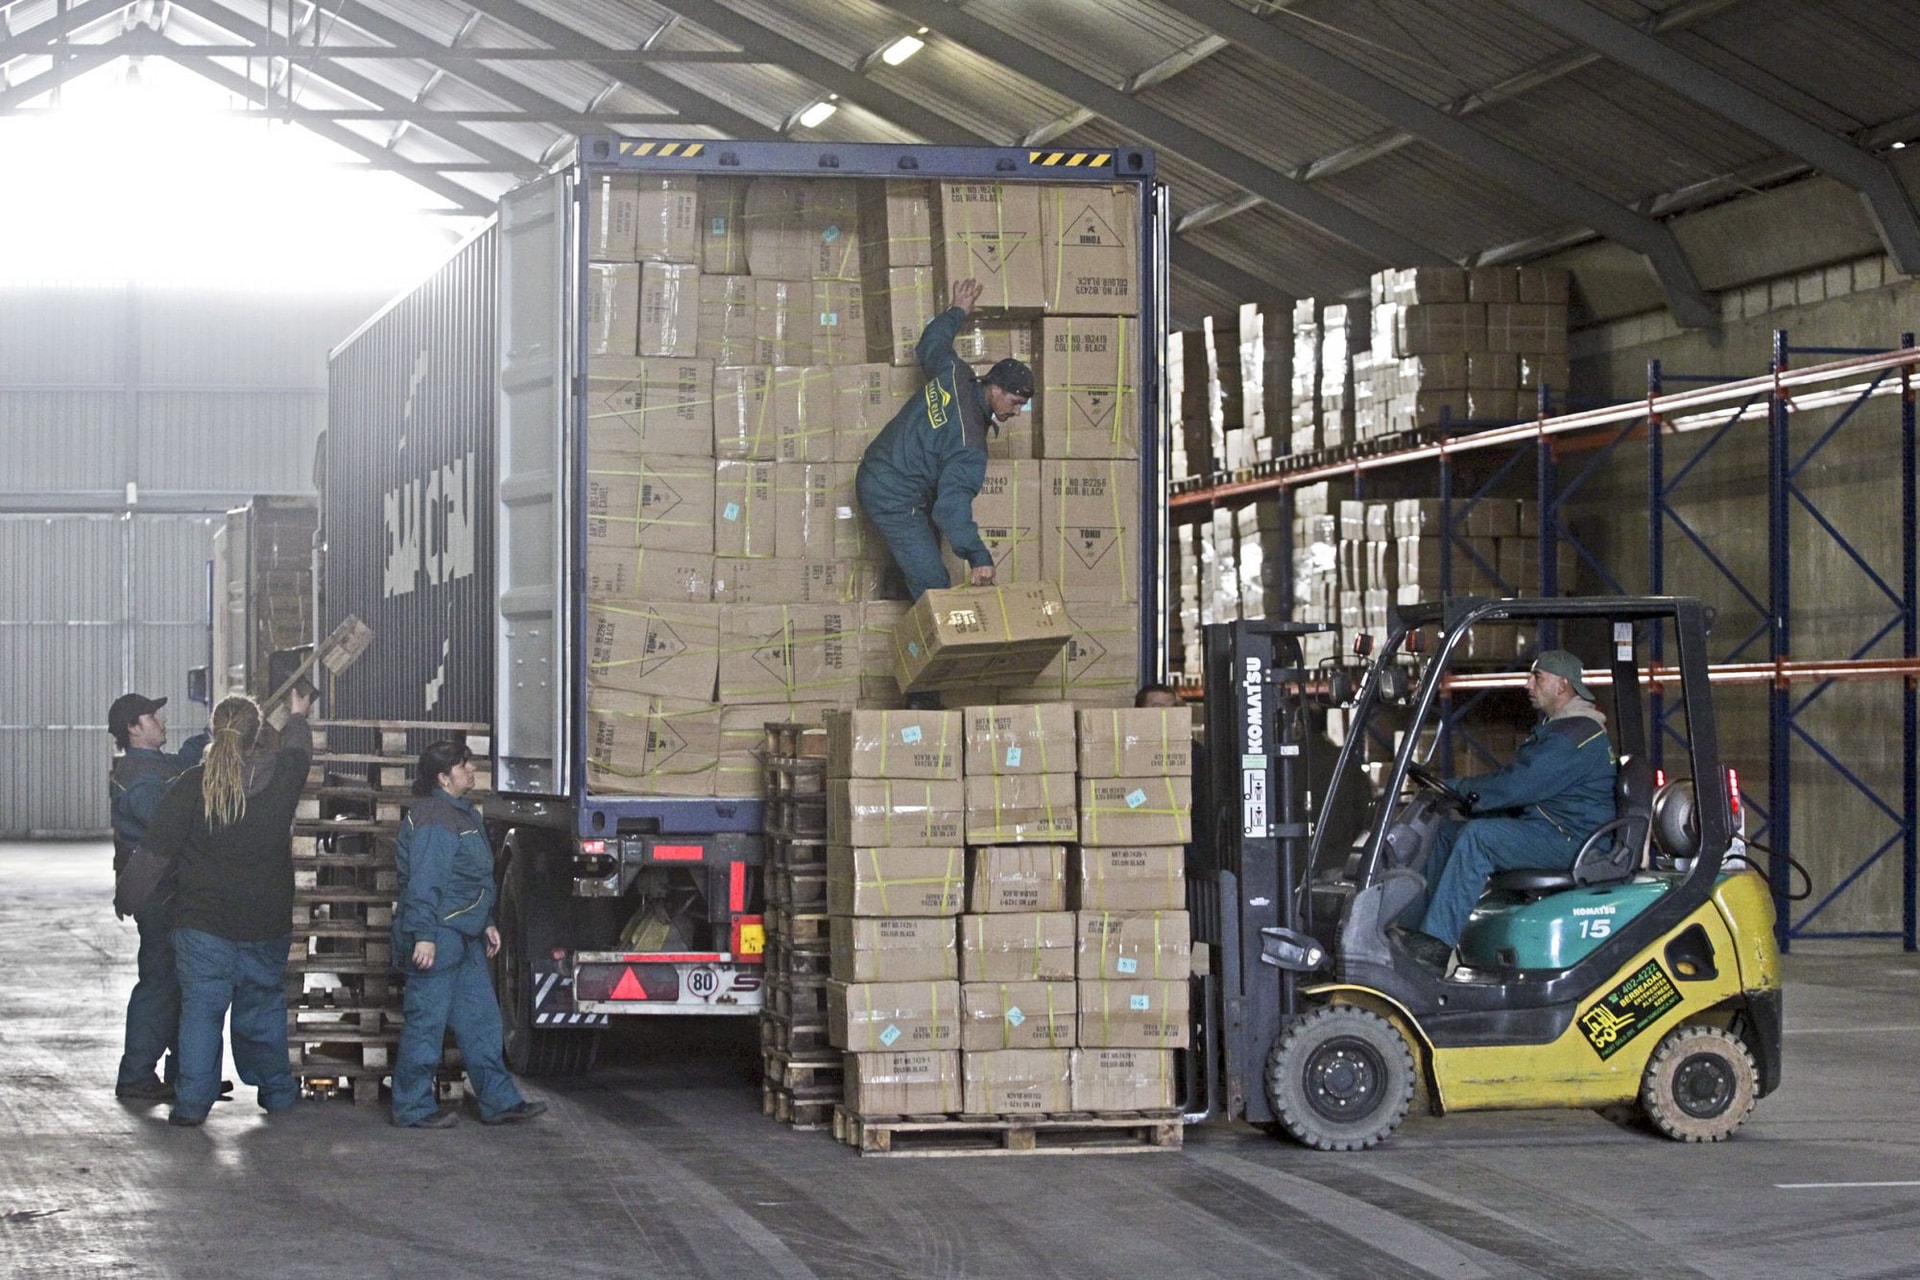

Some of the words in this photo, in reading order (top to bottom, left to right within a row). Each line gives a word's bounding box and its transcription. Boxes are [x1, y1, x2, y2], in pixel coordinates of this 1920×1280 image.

[1115, 288, 1127, 296] ART
[1055, 335, 1068, 343] ART
[1242, 657, 1263, 754] KOMATSU
[1573, 905, 1616, 916] KOMATSU
[1579, 919, 1611, 939] 15
[693, 973, 713, 991] 80
[1622, 963, 1659, 994] 402-4222
[1619, 971, 1663, 1008] BÉRBEADÁS
